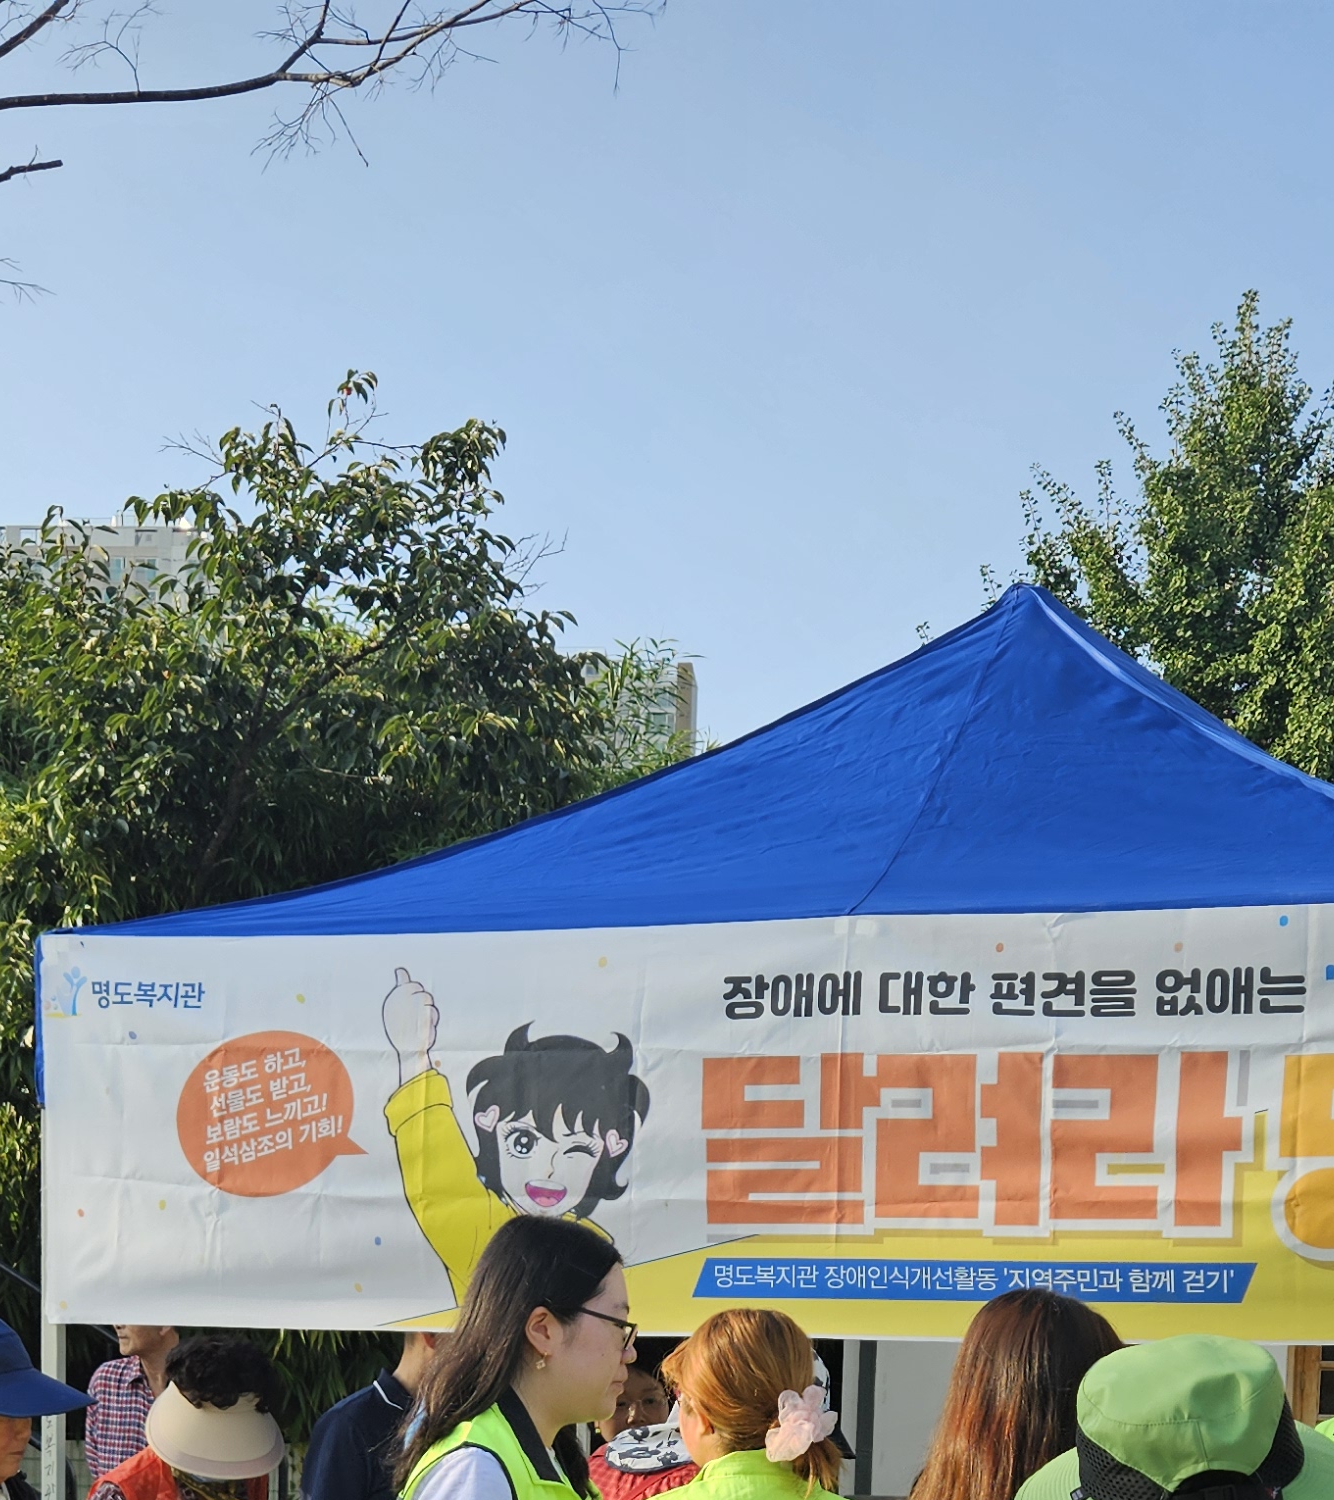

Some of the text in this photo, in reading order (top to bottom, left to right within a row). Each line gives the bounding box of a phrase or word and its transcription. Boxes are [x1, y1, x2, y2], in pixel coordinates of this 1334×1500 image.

[91, 979, 206, 1010] 명도복지관
[722, 970, 862, 1020] 장애에
[879, 970, 975, 1017] 대한
[990, 969, 1137, 1019] 편견을
[1155, 966, 1307, 1018] 없애는
[203, 1048, 306, 1093] 운동도 하고,
[206, 1093, 328, 1145] 보람도 느끼고!
[210, 1073, 312, 1118] 선물도 받고,
[203, 1115, 343, 1173] 일석삼조의 기회!
[701, 1050, 1243, 1228] 달려라
[714, 1264, 1234, 1293] 명도복지관 장애인식개선활동 '지역주민과 함께 걷기'
